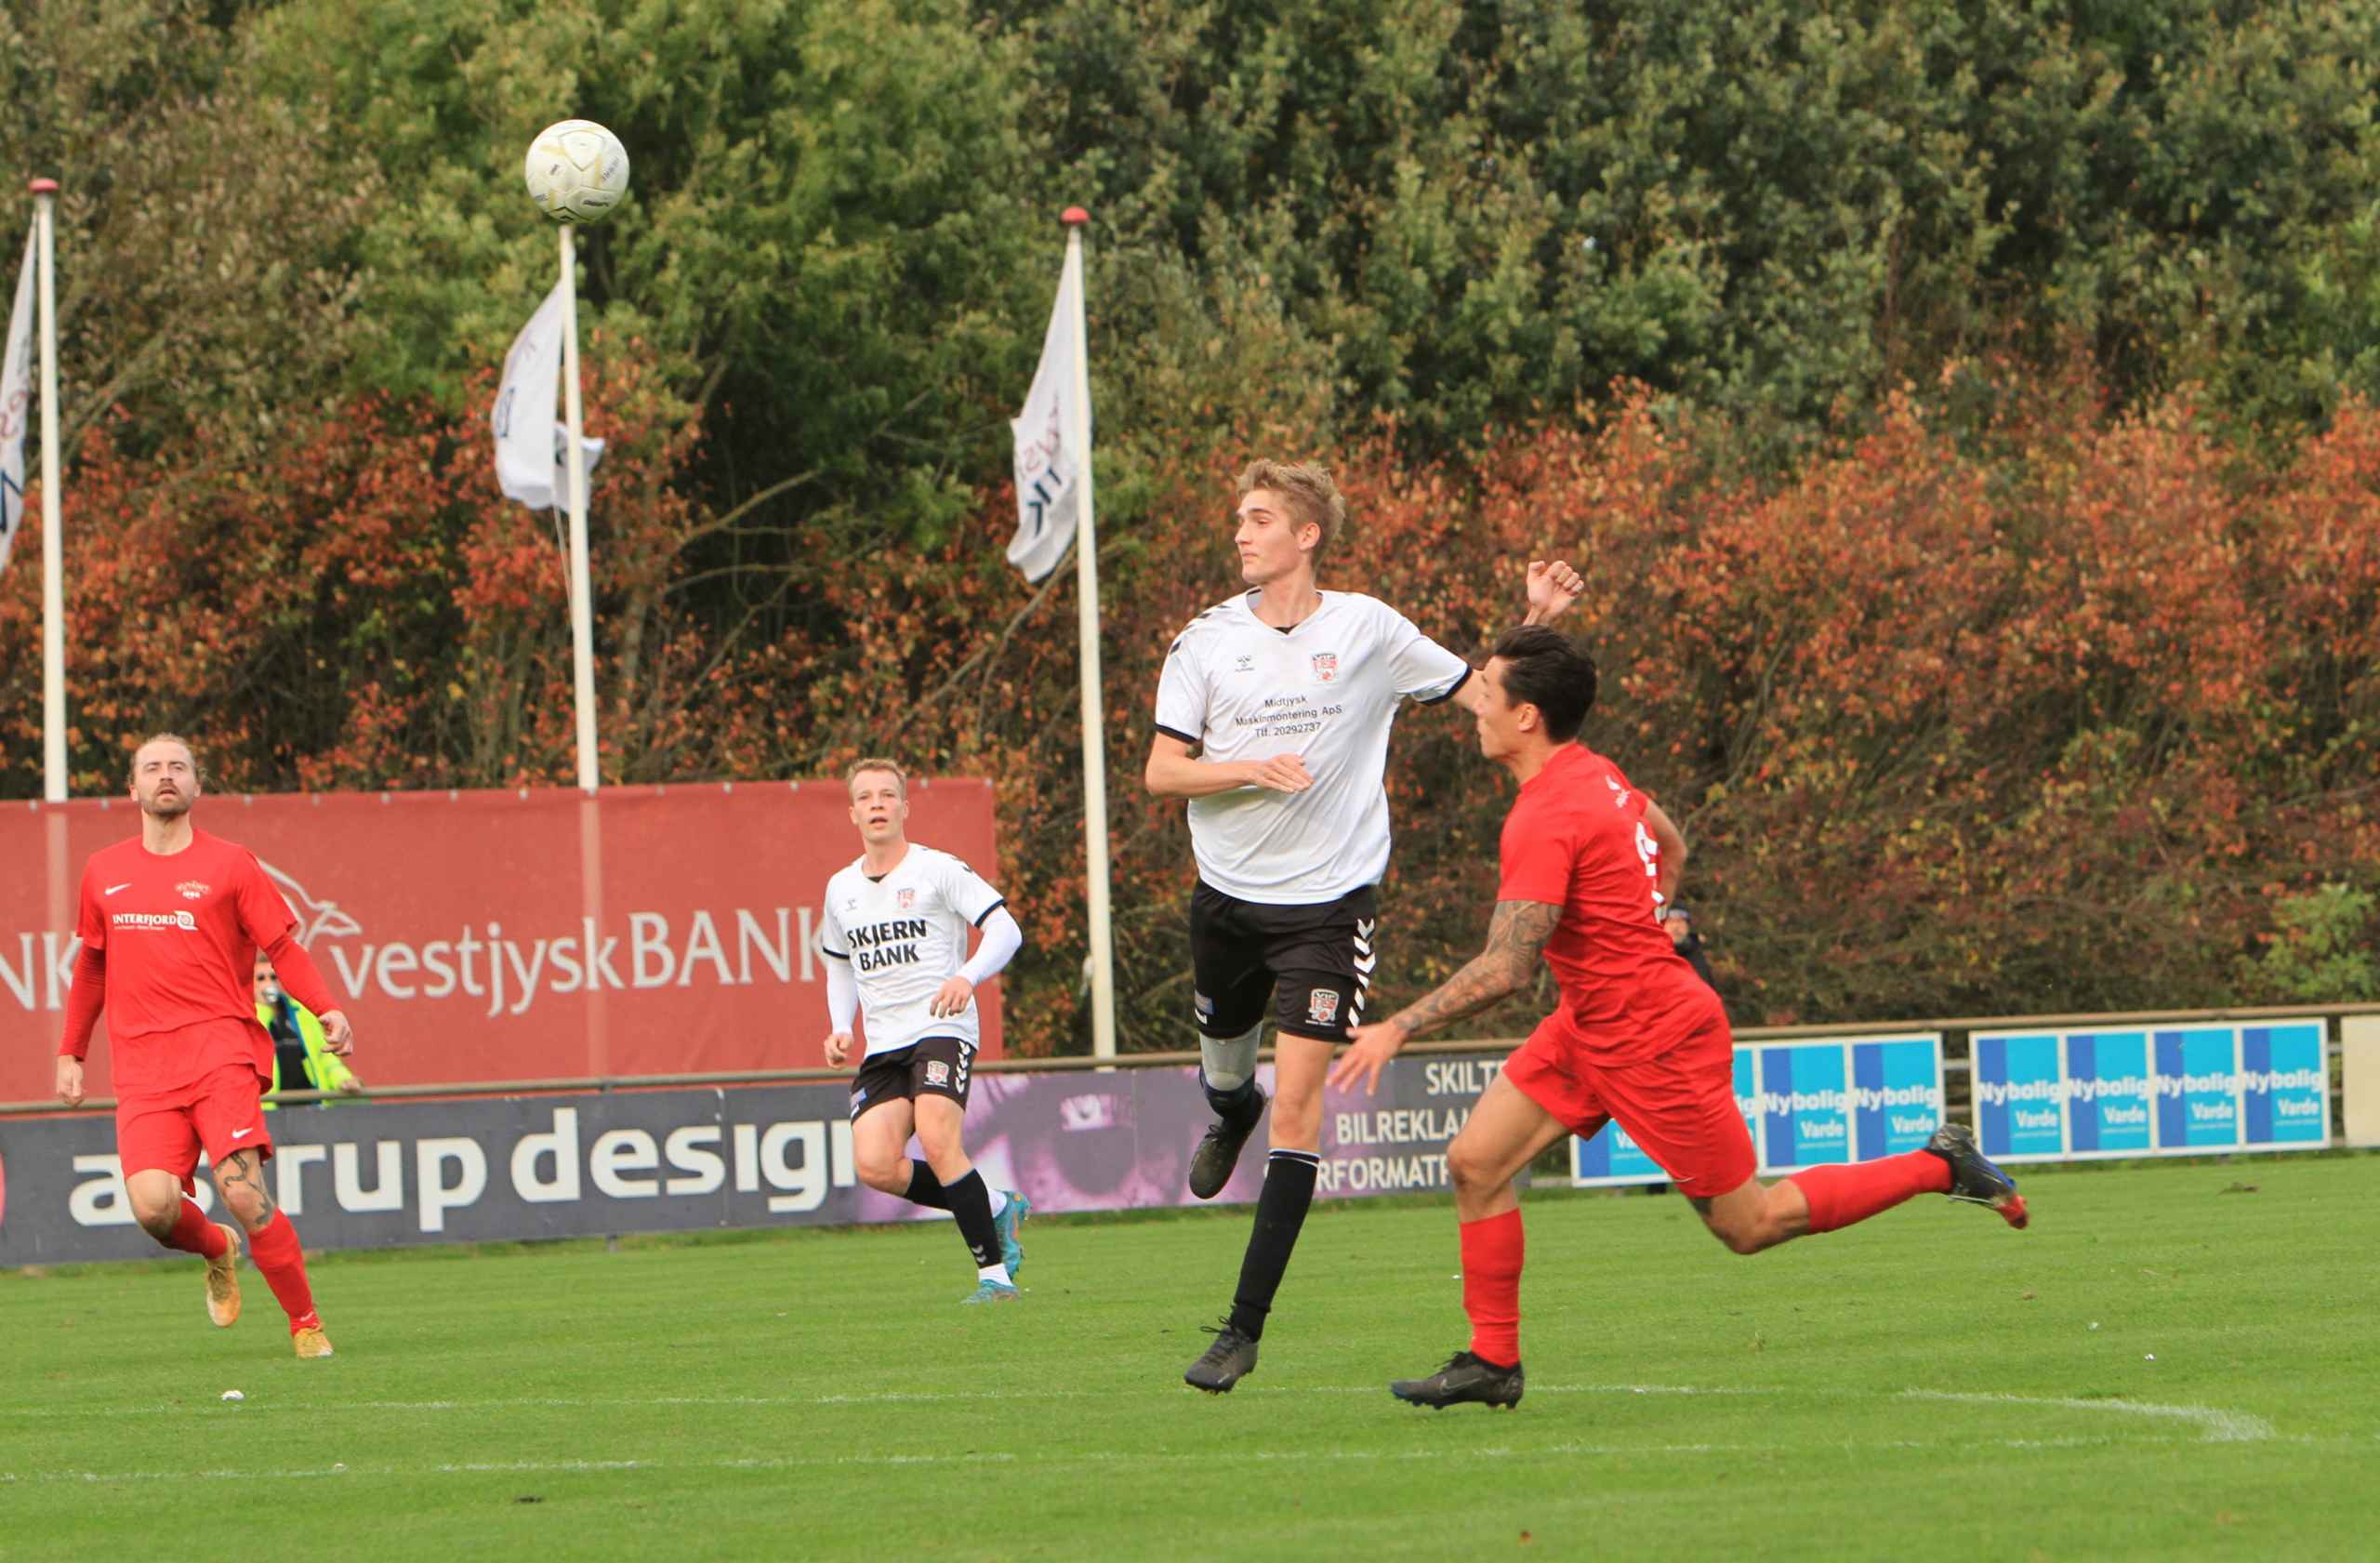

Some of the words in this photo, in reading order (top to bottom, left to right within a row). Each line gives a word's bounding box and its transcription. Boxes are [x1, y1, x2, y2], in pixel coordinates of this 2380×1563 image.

[1322, 705, 1342, 716] ApS
[112, 913, 177, 926] INTERFJORD
[847, 919, 928, 948] SKJERN
[859, 944, 920, 972] BANK
[1425, 1061, 1508, 1095] SKILT
[2067, 1075, 2150, 1103] Nybolig
[2155, 1071, 2237, 1099] Nybolig
[2242, 1066, 2323, 1095] Nybolig
[1763, 1089, 1846, 1117] Nybolig
[1854, 1084, 1937, 1112] Nybolig
[1978, 1080, 2061, 1106] Nybolig
[2278, 1096, 2320, 1117] Varde
[1891, 1114, 1935, 1133] Varde
[2016, 1109, 2058, 1129] Varde
[2103, 1105, 2146, 1124] Varde
[2190, 1100, 2233, 1120] Varde
[1335, 1107, 1469, 1145] BILREKLA
[1800, 1119, 1845, 1139] Varde
[69, 1136, 487, 1233] arup
[1263, 1153, 1450, 1192] RFORMAT
